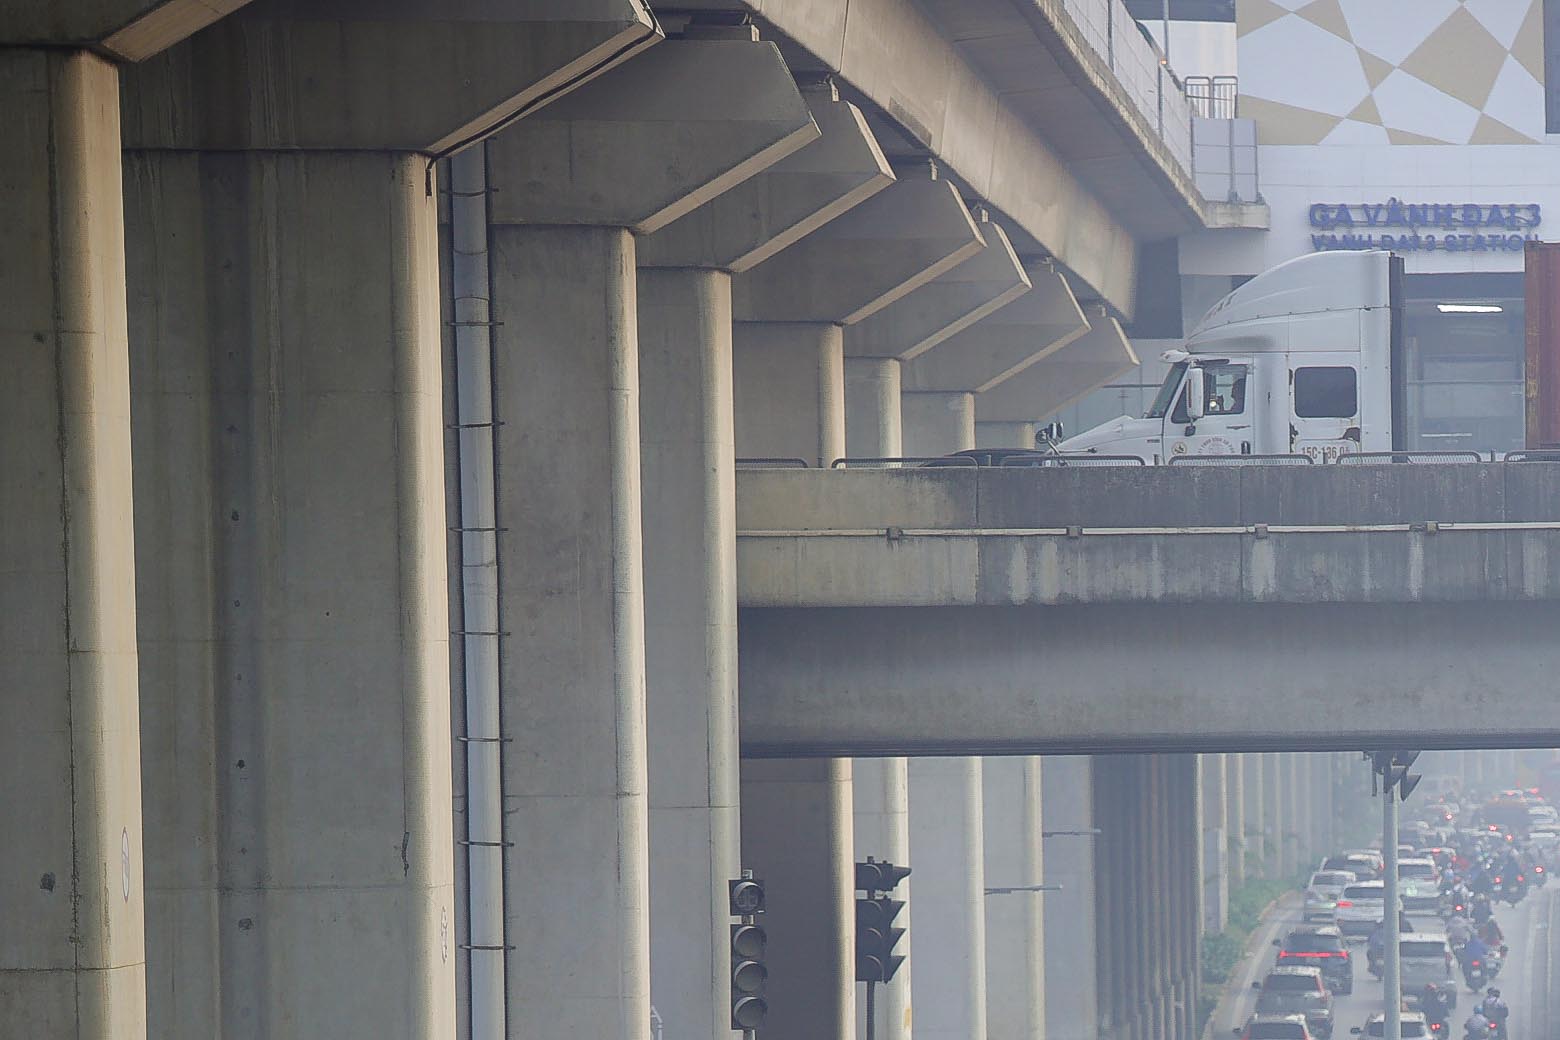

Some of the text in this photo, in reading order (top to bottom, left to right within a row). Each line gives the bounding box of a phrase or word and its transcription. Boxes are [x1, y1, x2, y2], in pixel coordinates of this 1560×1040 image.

[1309, 203, 1354, 228] GA
[1526, 203, 1542, 228] 3
[1426, 233, 1437, 251] 3
